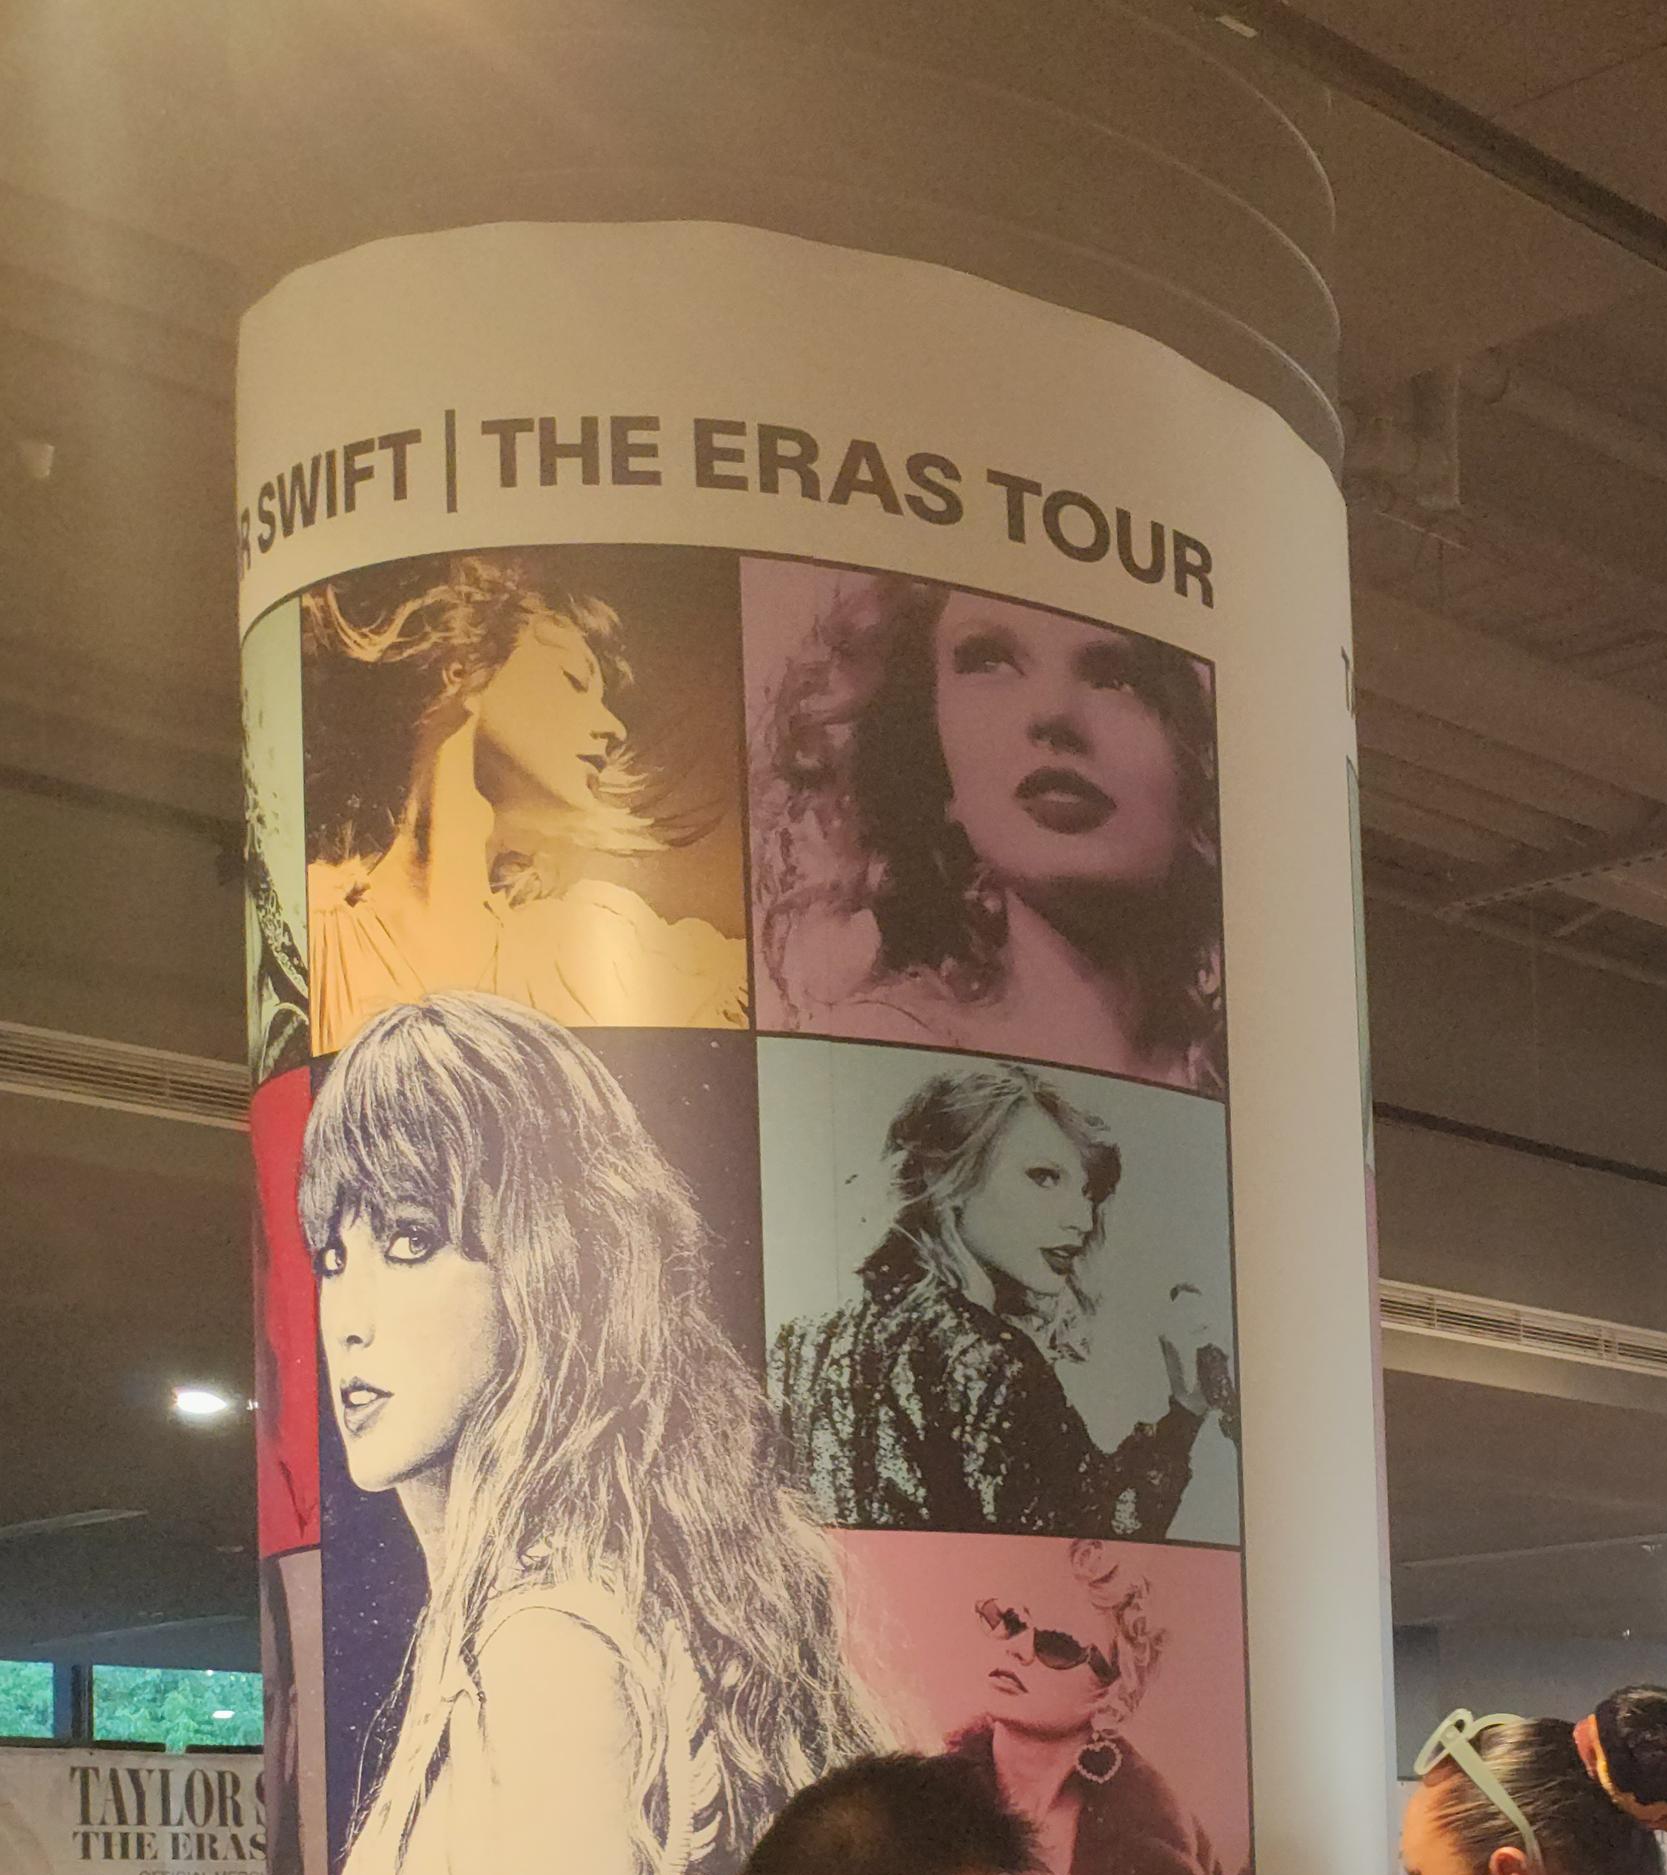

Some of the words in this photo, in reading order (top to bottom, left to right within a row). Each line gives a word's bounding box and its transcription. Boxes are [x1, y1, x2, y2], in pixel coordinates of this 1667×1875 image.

[257, 428, 422, 554] SWIFT
[480, 415, 661, 488] THE
[693, 417, 964, 526] ERAS
[986, 468, 1214, 609] TOUR
[69, 1766, 243, 1827] TAYLOR
[73, 1831, 158, 1860] THE
[169, 1831, 266, 1860] ERAS
